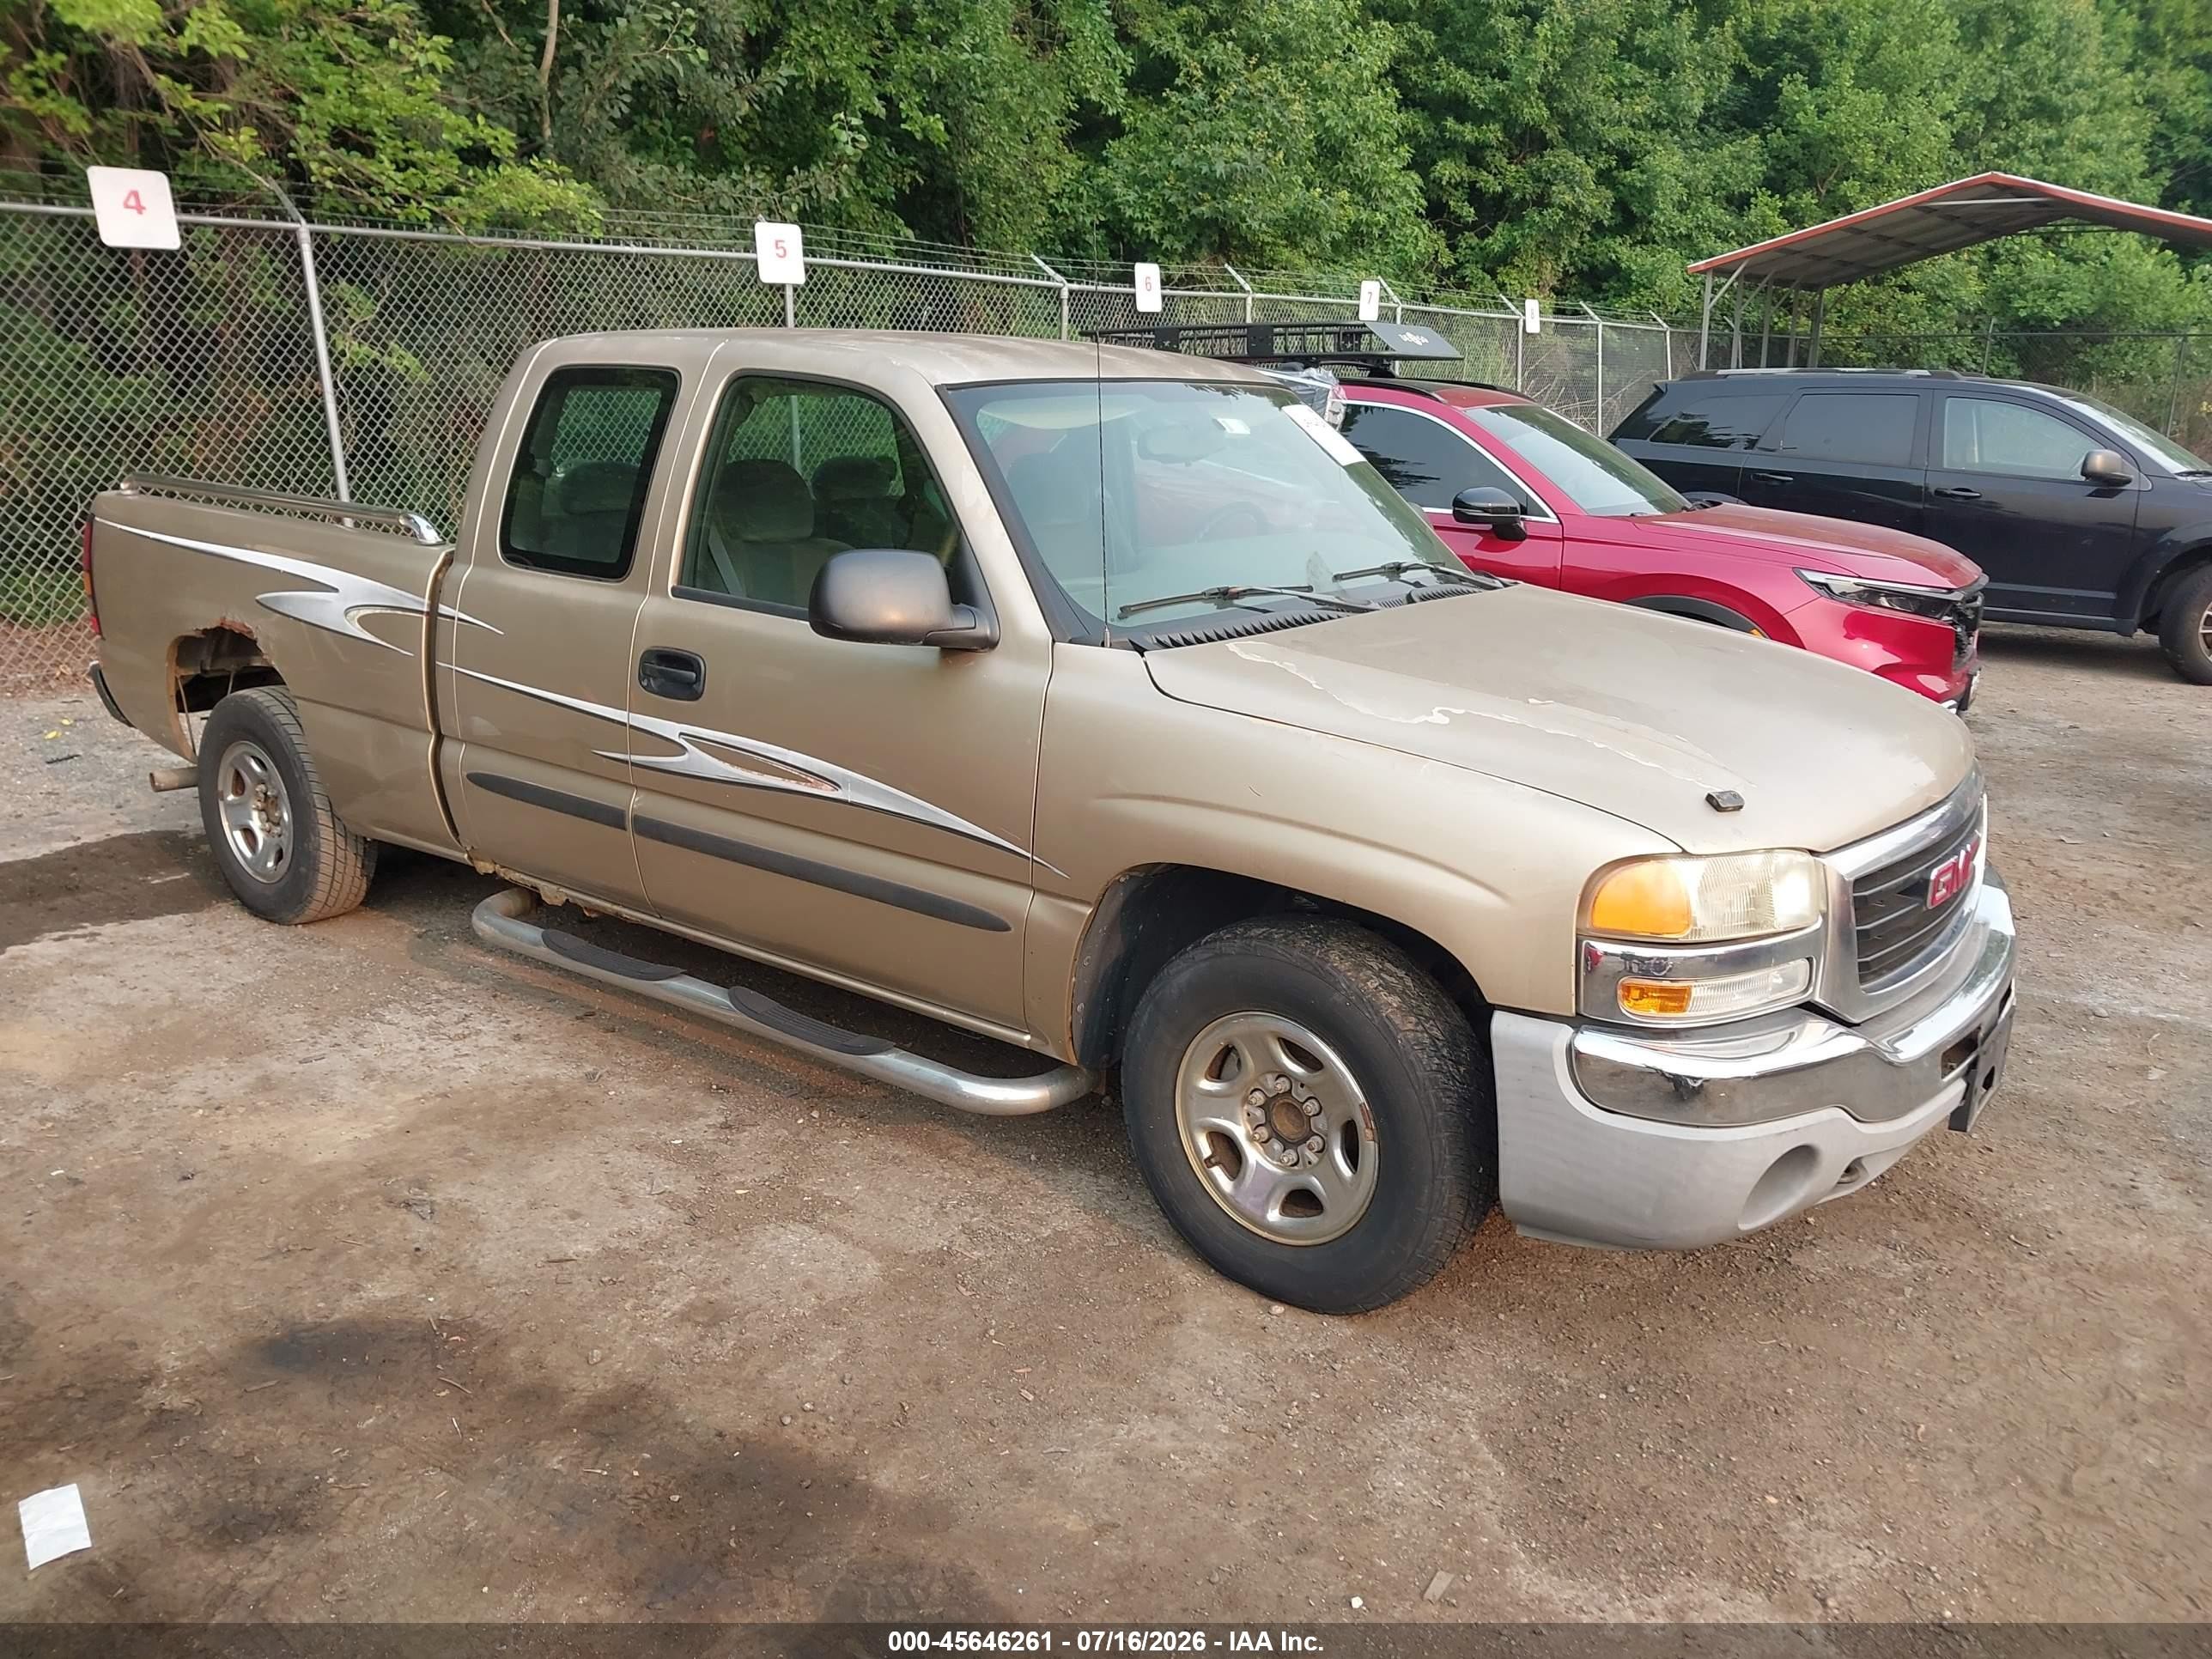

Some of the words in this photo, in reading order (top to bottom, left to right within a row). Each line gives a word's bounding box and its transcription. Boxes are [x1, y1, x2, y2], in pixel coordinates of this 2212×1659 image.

[123, 190, 146, 215] 4
[775, 240, 787, 258] 5
[1145, 276, 1152, 291] 6
[1368, 291, 1373, 304] 7
